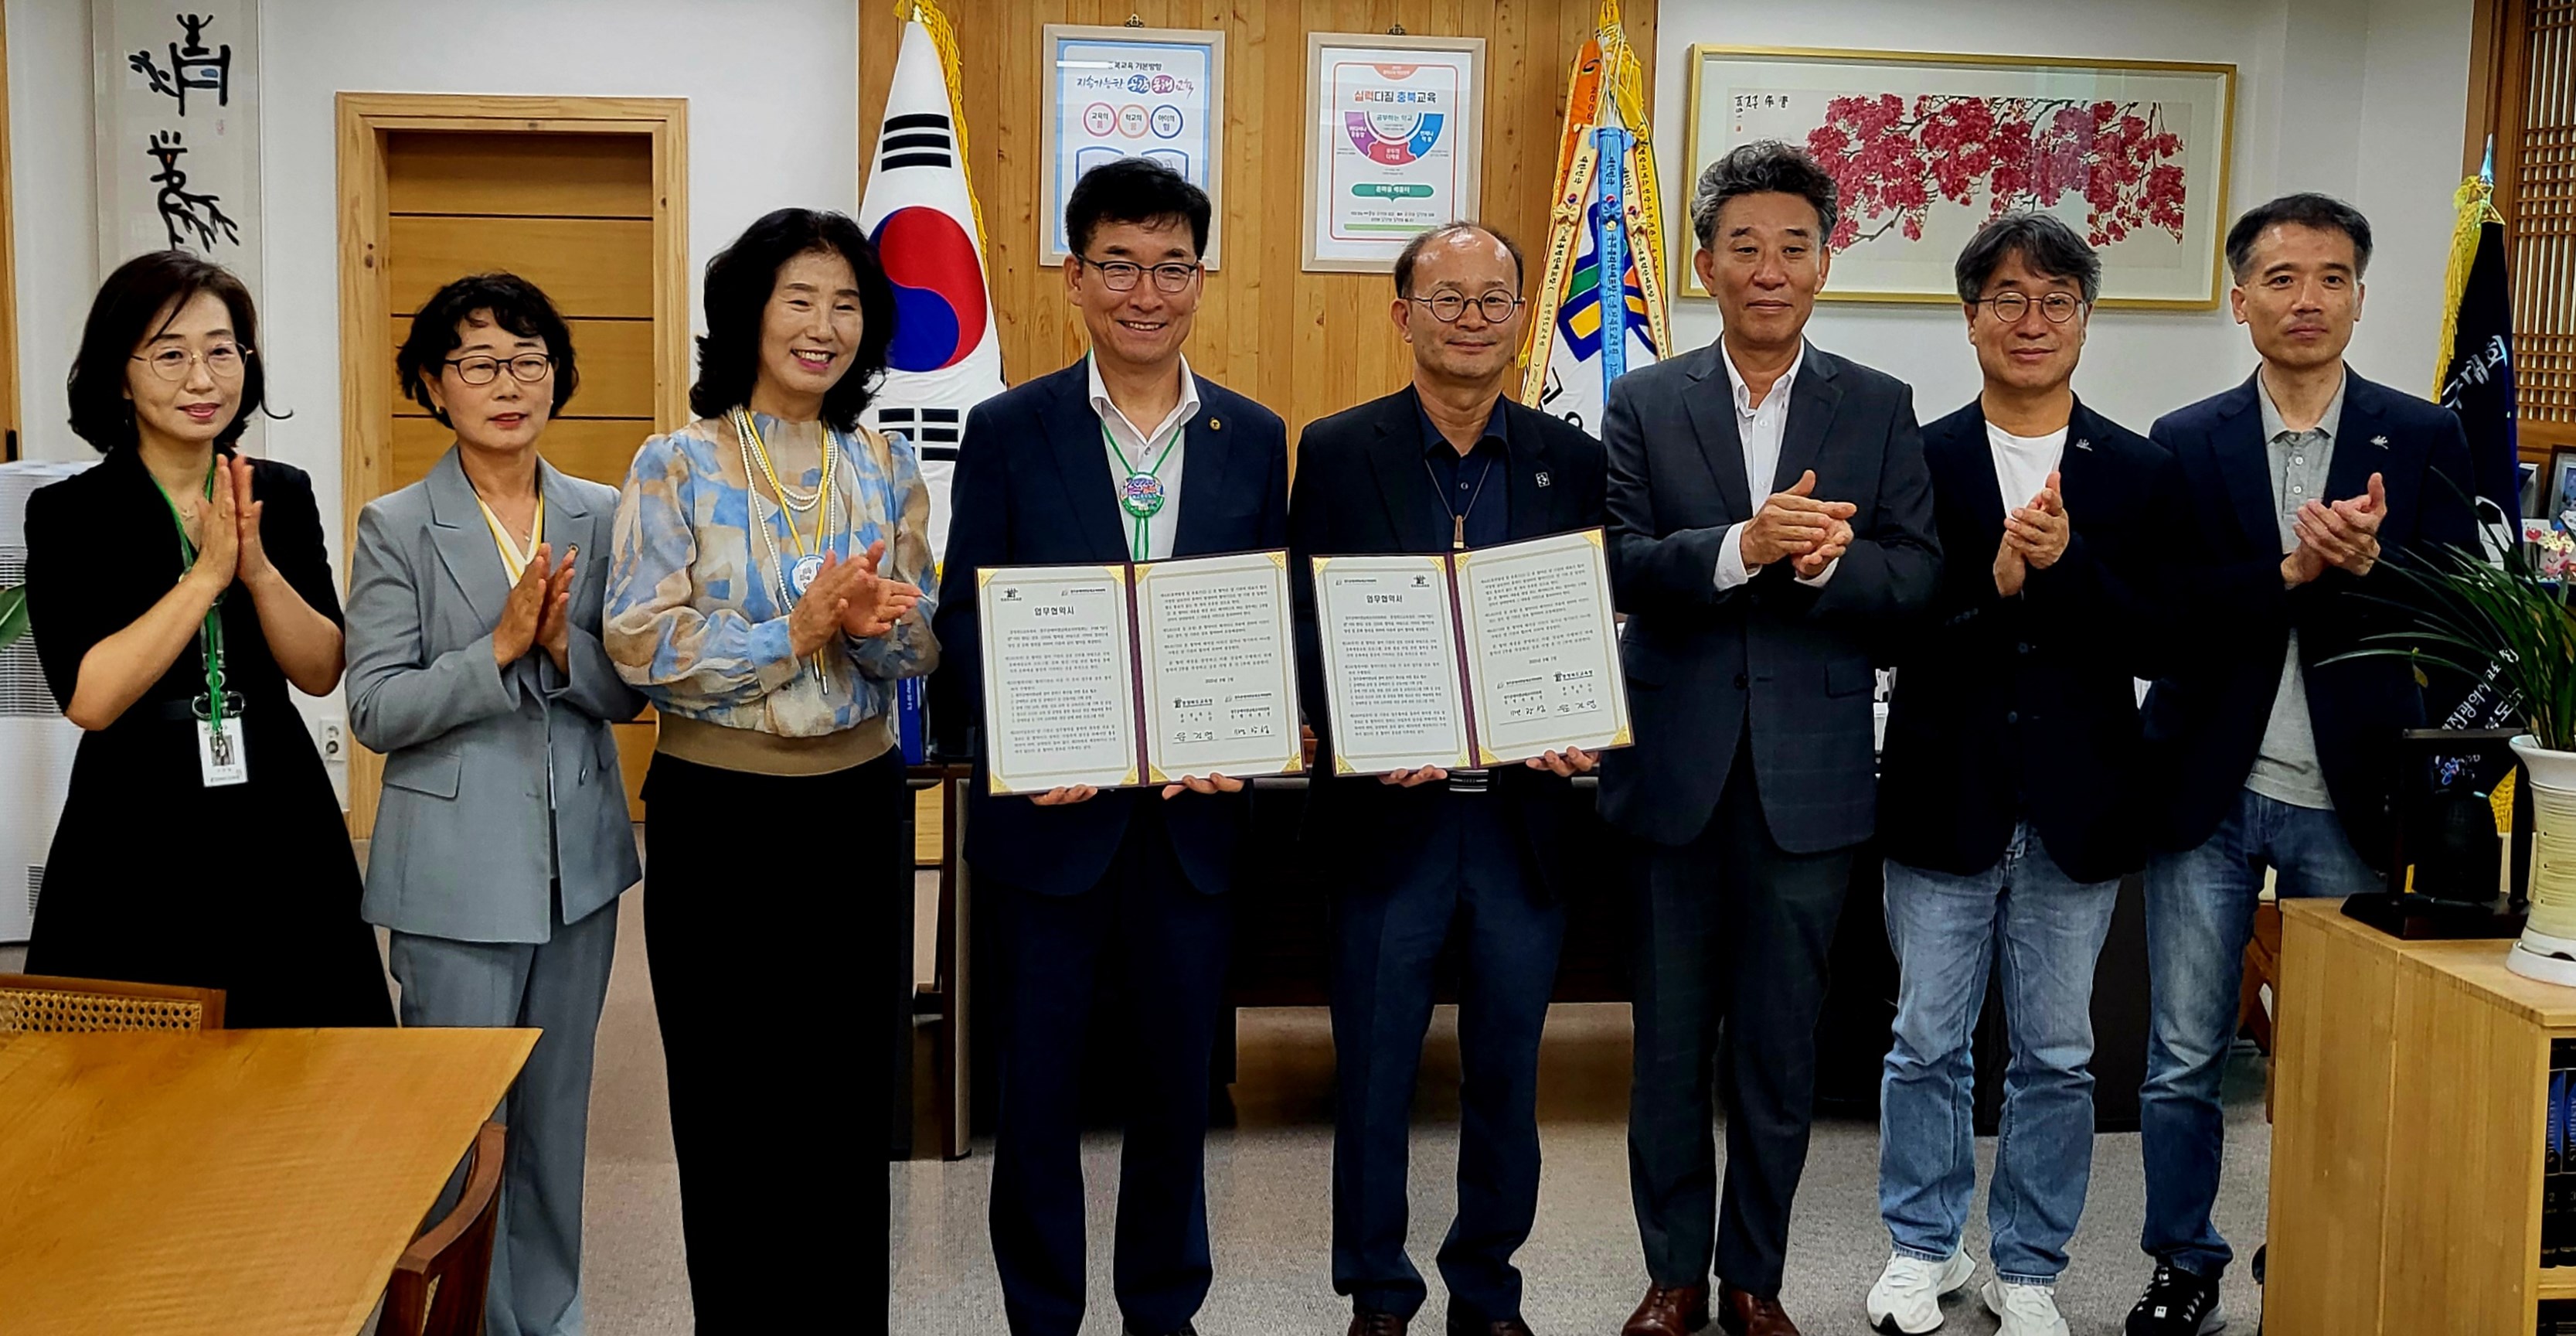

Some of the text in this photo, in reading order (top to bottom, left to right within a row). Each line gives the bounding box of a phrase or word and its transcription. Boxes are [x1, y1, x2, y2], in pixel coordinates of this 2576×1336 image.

[1108, 61, 1134, 70] 북교육
[1355, 90, 1437, 103] 실력다짐 충북교육
[1574, 155, 1589, 185] 대한민국
[1605, 157, 1616, 186] 대한민국
[1366, 595, 1403, 603] 업무협약서
[1034, 605, 1075, 616] 업무협약서
